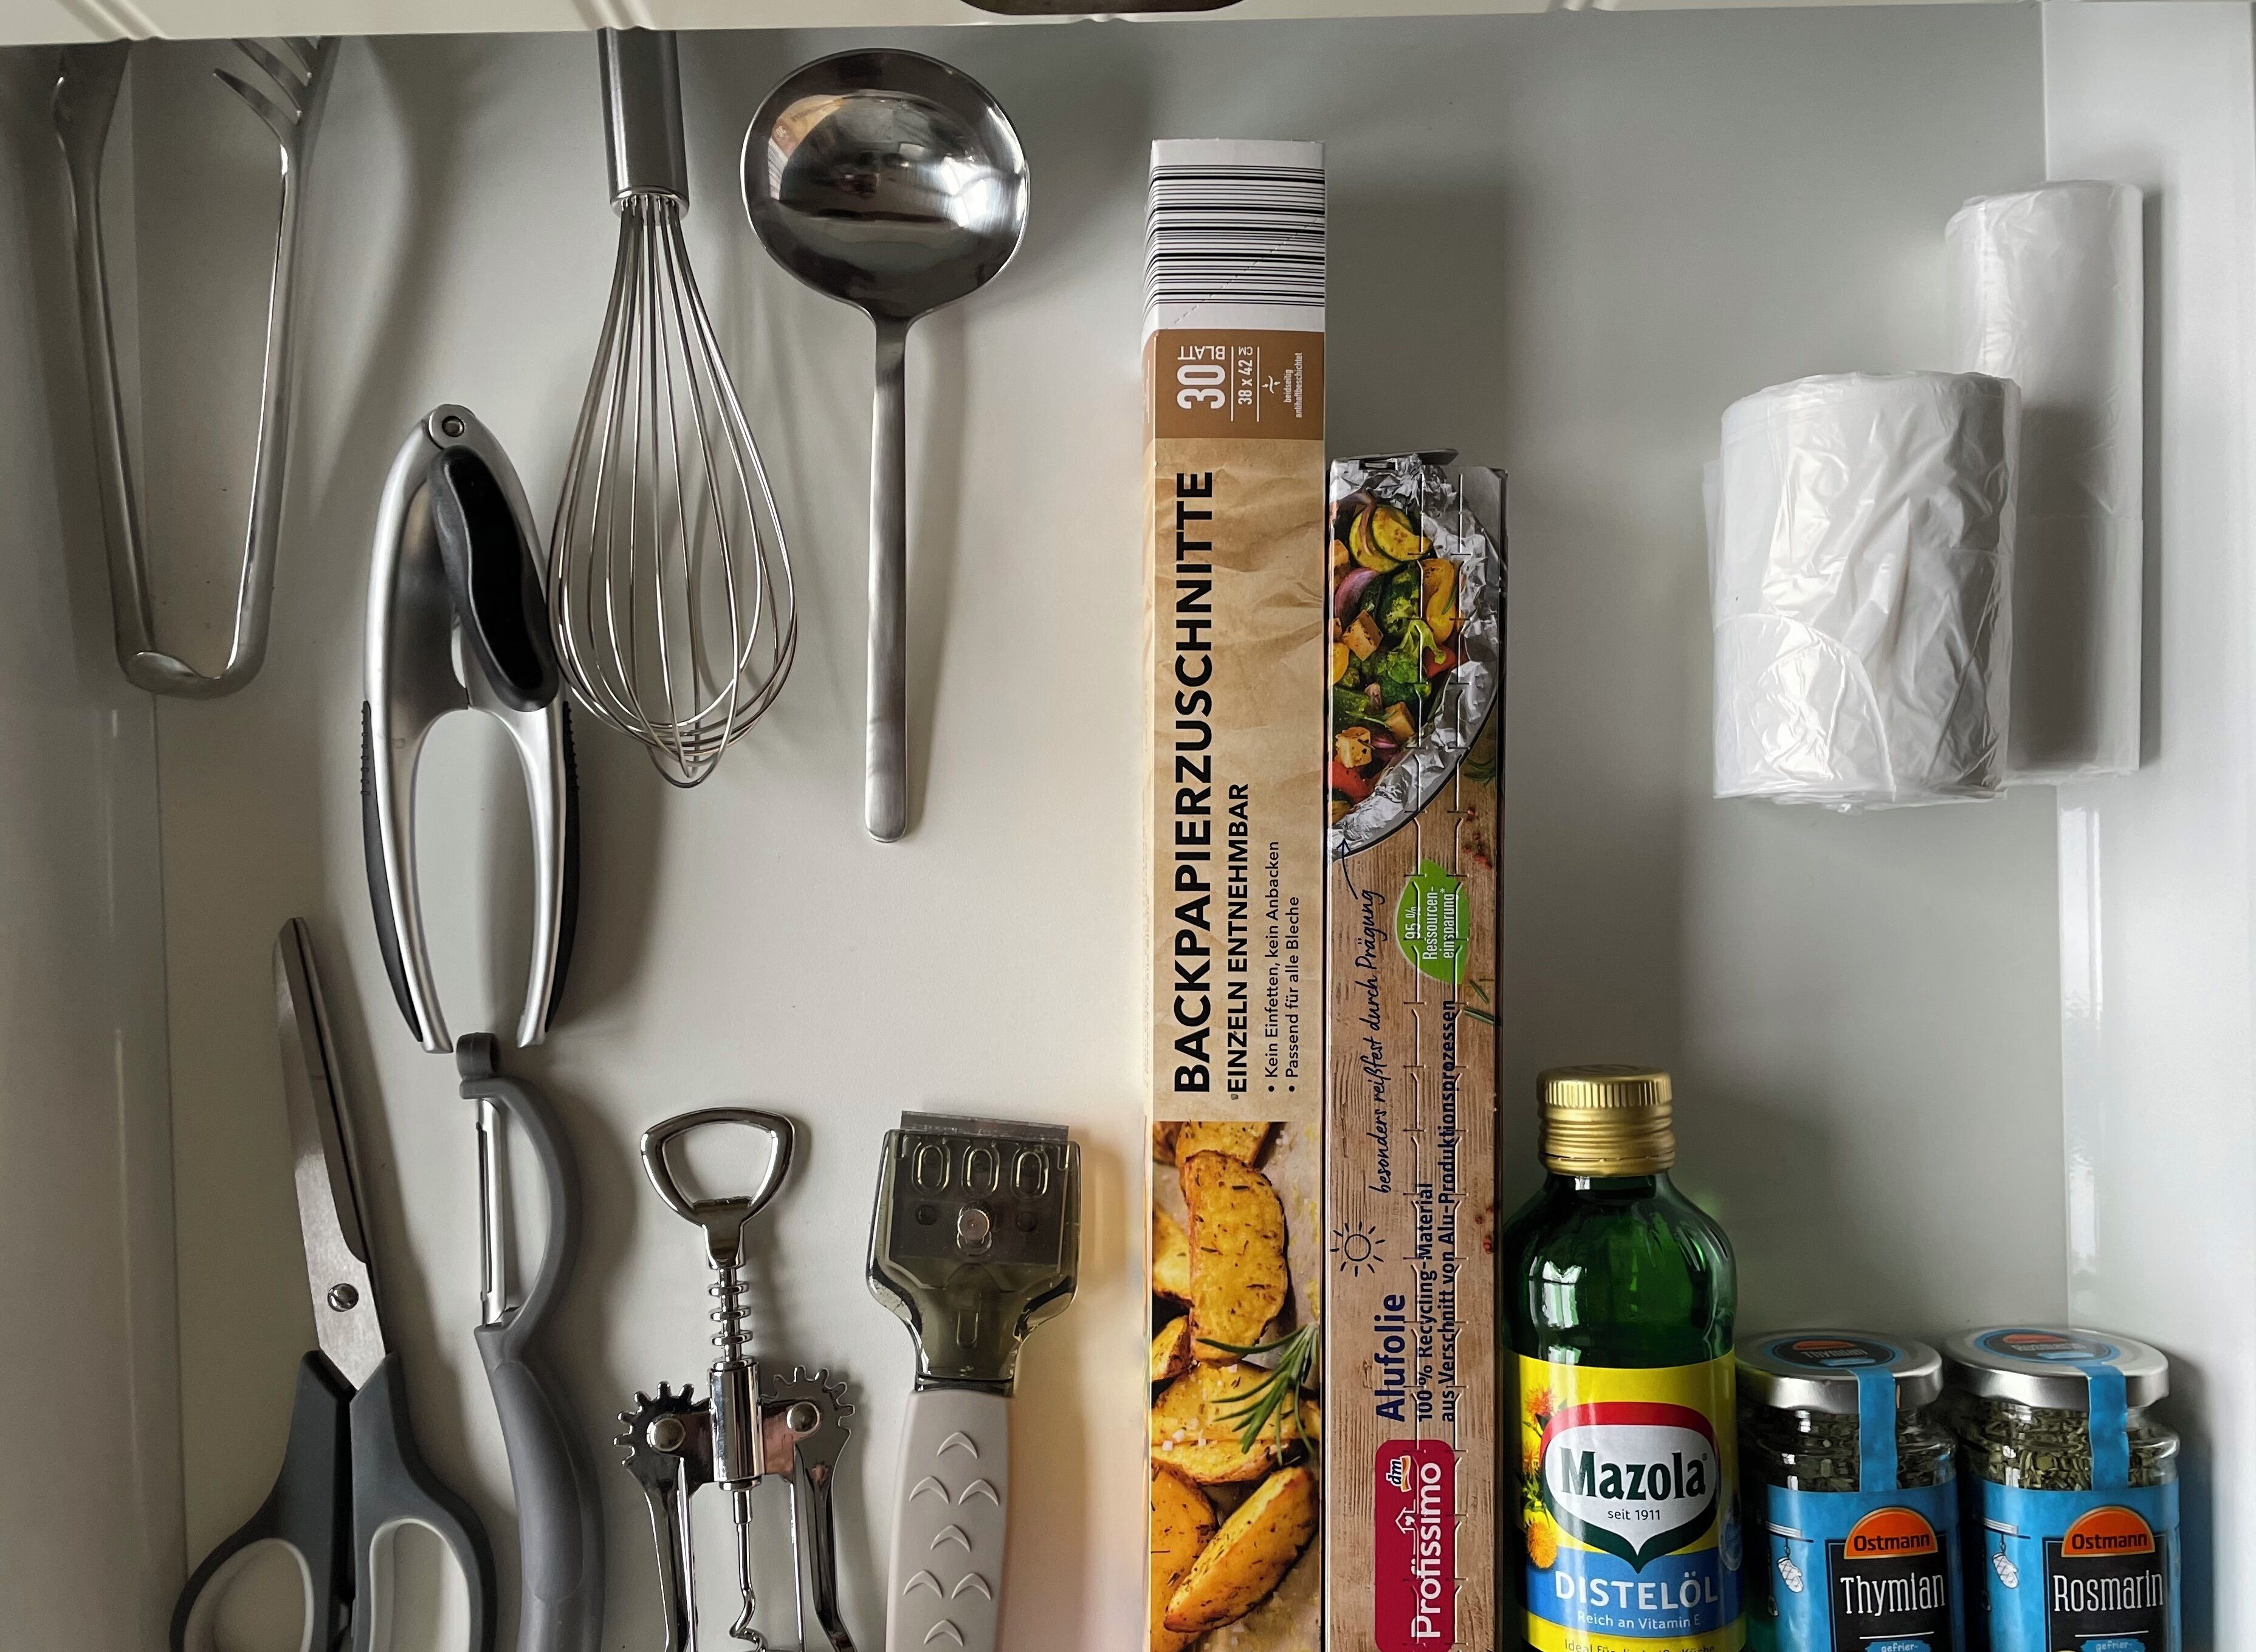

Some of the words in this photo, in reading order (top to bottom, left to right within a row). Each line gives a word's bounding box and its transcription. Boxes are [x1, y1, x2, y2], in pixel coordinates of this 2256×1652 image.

[1177, 346, 1226, 360] BLATT
[1237, 359, 1253, 375] 42
[1238, 346, 1253, 355] CM
[1177, 365, 1226, 409] 30
[1237, 389, 1253, 405] 38
[1282, 369, 1294, 403] beidseitig
[1295, 352, 1303, 418] antihaftbeschichtet
[1174, 471, 1213, 1092] BACKPAPIERZUSCHNITTE
[1228, 783, 1249, 972] ENTNEHMBAR
[1265, 841, 1279, 921] Anbacken
[1285, 896, 1299, 950] Bleche
[1356, 889, 1388, 970] Prägung
[1405, 906, 1421, 919] %
[1405, 922, 1421, 939] 95
[1422, 886, 1438, 960] Ressourcen-
[1264, 925, 1279, 958] kein
[1285, 955, 1299, 982] alle
[1264, 962, 1281, 1037] Einfetten,
[1284, 987, 1299, 1010] für
[1357, 975, 1381, 1031] durch
[1227, 981, 1248, 1092] EINZELN
[1284, 1014, 1299, 1078] Passend
[1265, 1043, 1279, 1078] Kein
[1361, 1035, 1391, 1102] reißfest
[1437, 999, 1460, 1245] Alu-Produktionsprozessen
[1367, 1109, 1392, 1193] besonders
[1416, 1184, 1438, 1358] Recycling-Material
[1441, 1250, 1456, 1285] von
[1437, 1290, 1456, 1385] Verschnitt
[1374, 1294, 1406, 1422] Alufolie
[1417, 1365, 1434, 1385] %
[1417, 1386, 1434, 1422] 100
[1442, 1390, 1456, 1422] aus
[1388, 1461, 1403, 1486] dm
[1560, 1448, 1707, 1502] Mazola
[1608, 1507, 1631, 1520] seit
[1635, 1509, 1662, 1521] 1911
[1411, 1462, 1442, 1639] Profissimo
[1854, 1534, 1930, 1551] Ostmann
[2072, 1534, 2147, 1549] Ostmann
[1555, 1571, 1719, 1610] DISTELÖL
[1840, 1572, 1945, 1616] Thymian
[2053, 1570, 2164, 1612] Rosmarin
[1578, 1611, 1614, 1627] Reich
[1618, 1617, 1634, 1629] an
[1639, 1616, 1691, 1630] Vitamin
[1694, 1614, 1701, 1626] E
[1564, 1639, 1593, 1652] Ideal
